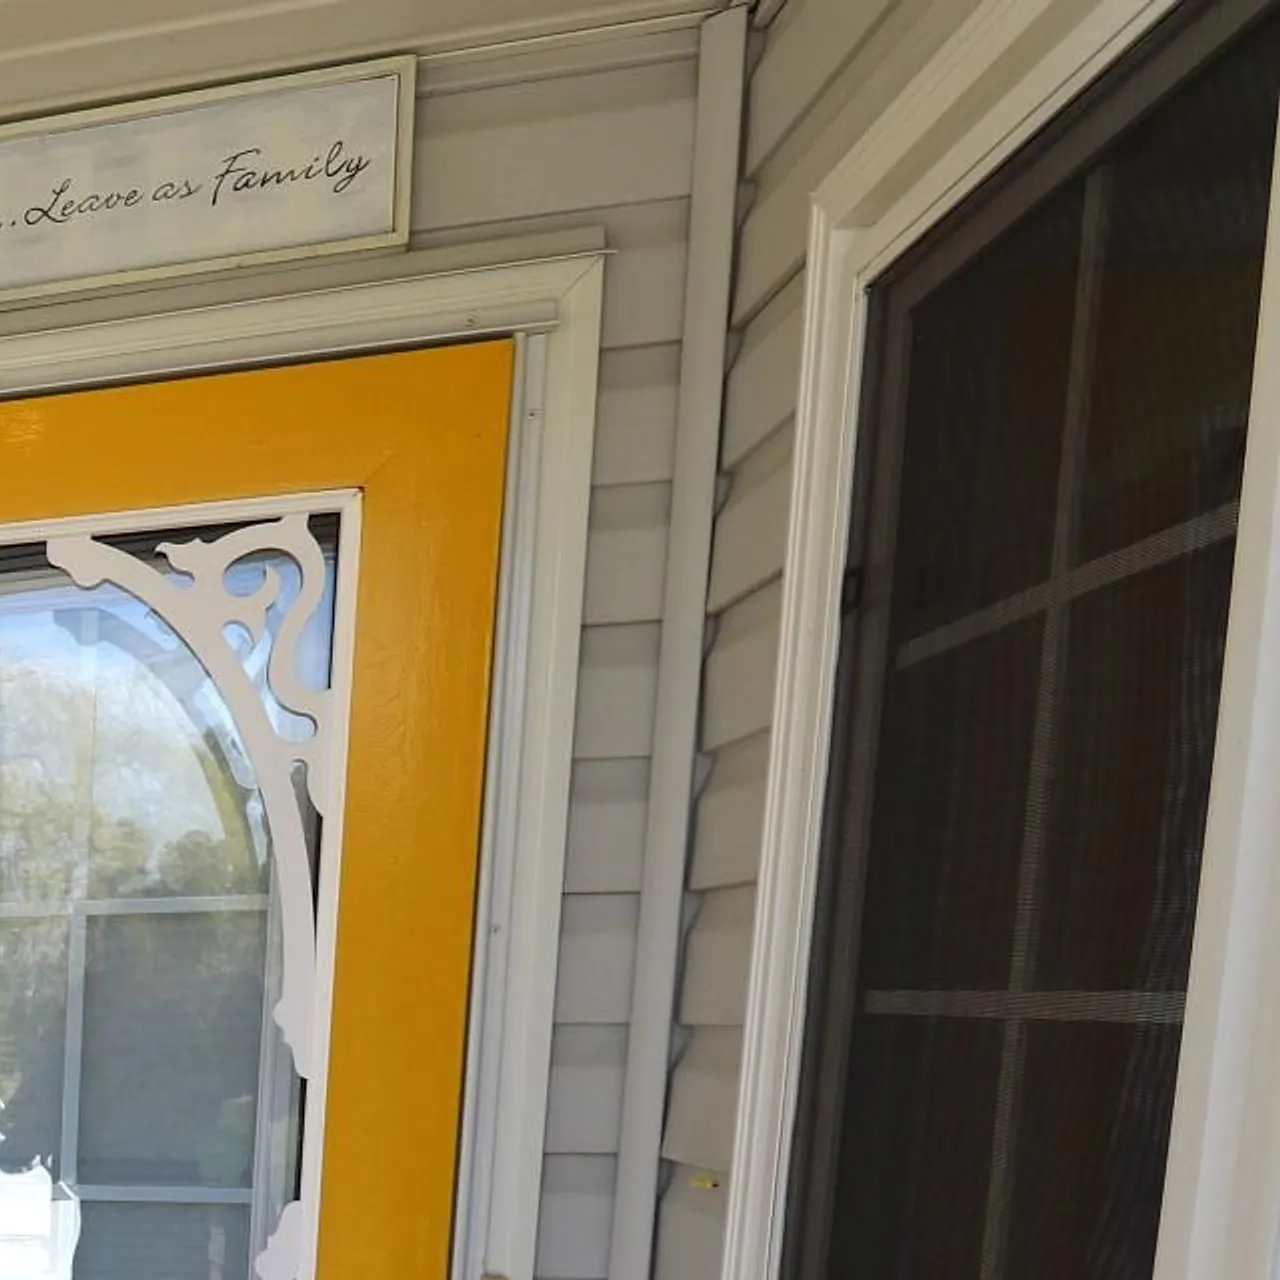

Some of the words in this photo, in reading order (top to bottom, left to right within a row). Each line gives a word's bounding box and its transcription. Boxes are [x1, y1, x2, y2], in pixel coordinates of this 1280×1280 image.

[24, 178, 142, 226] Leave
[151, 180, 203, 202] as
[210, 140, 372, 206] Family
